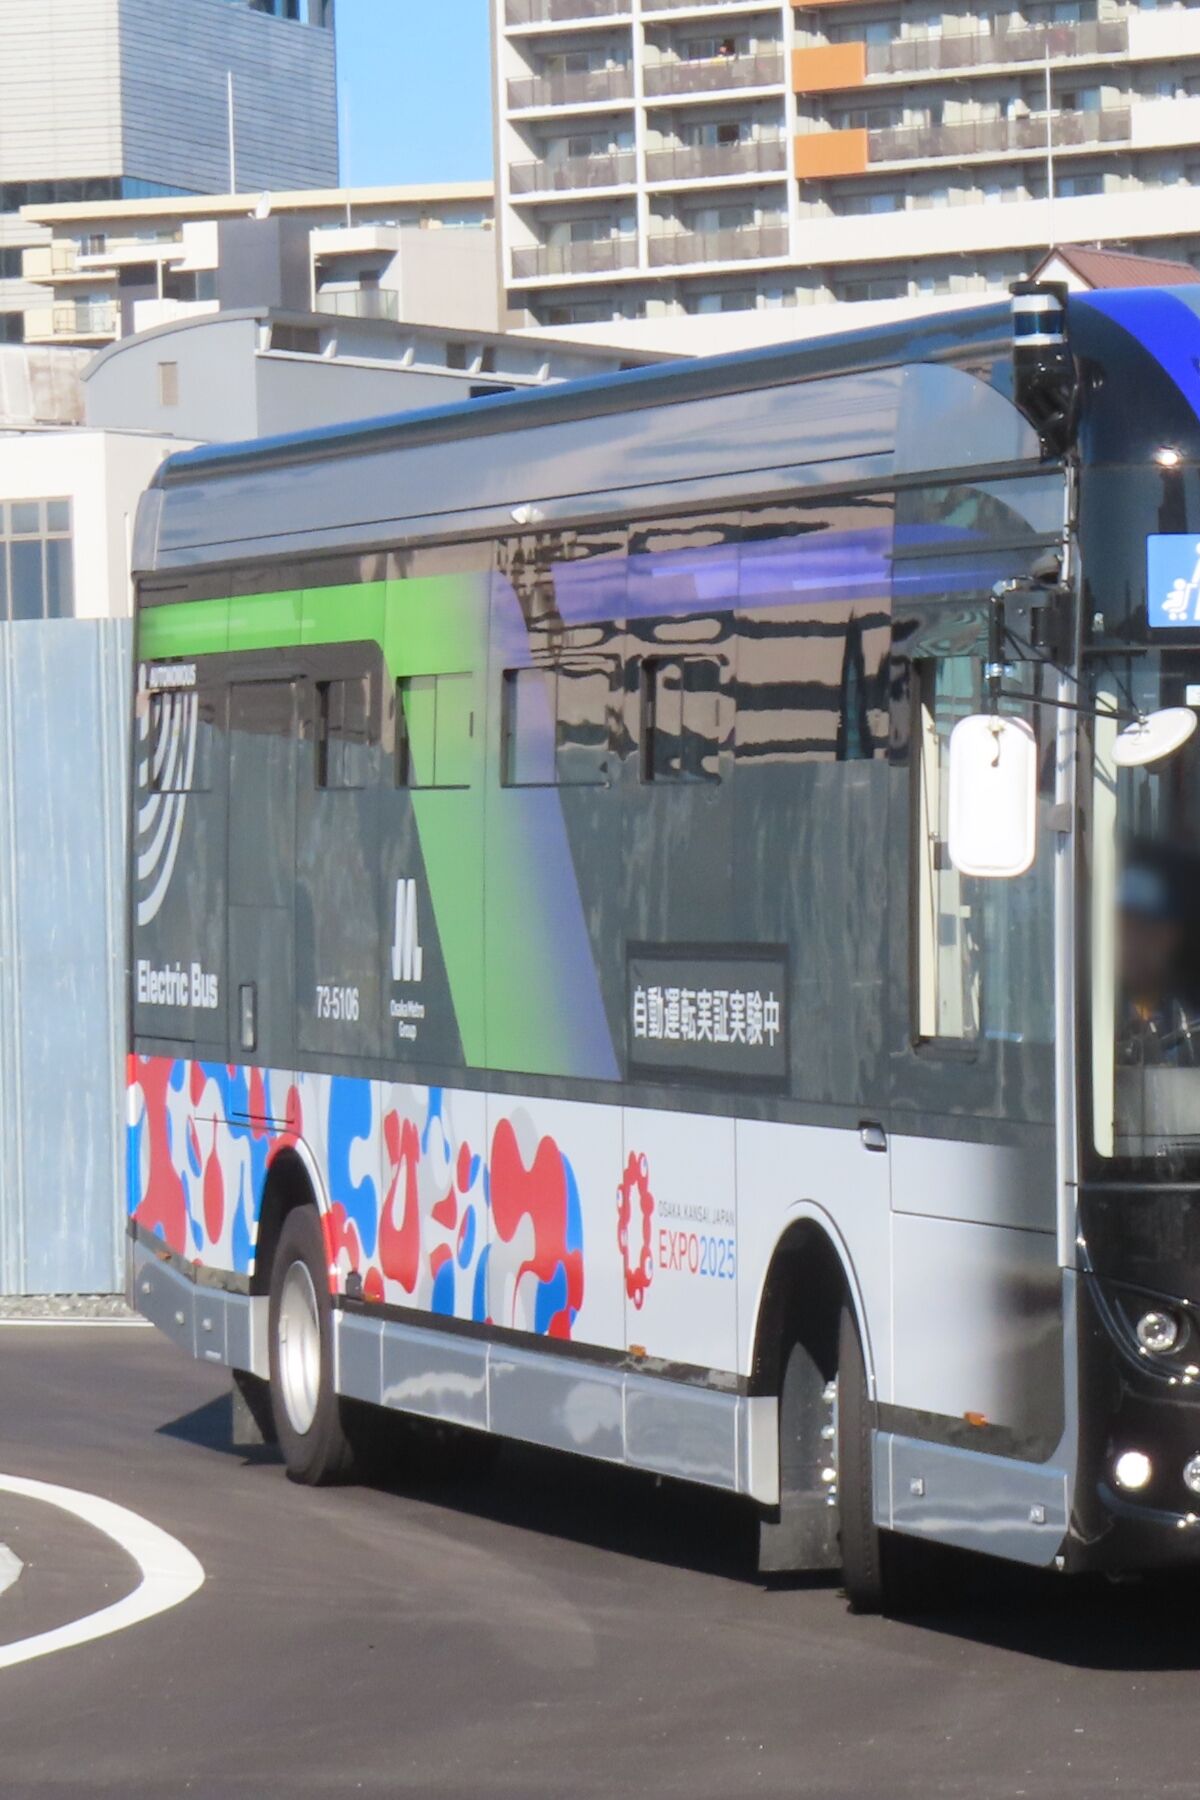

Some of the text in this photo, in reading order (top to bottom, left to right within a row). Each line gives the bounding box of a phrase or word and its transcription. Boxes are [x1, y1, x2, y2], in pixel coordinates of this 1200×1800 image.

[137, 959, 219, 1009] Electric Bus
[316, 985, 360, 1021] 73-5106
[633, 984, 780, 1047] 自動運転実証実験中
